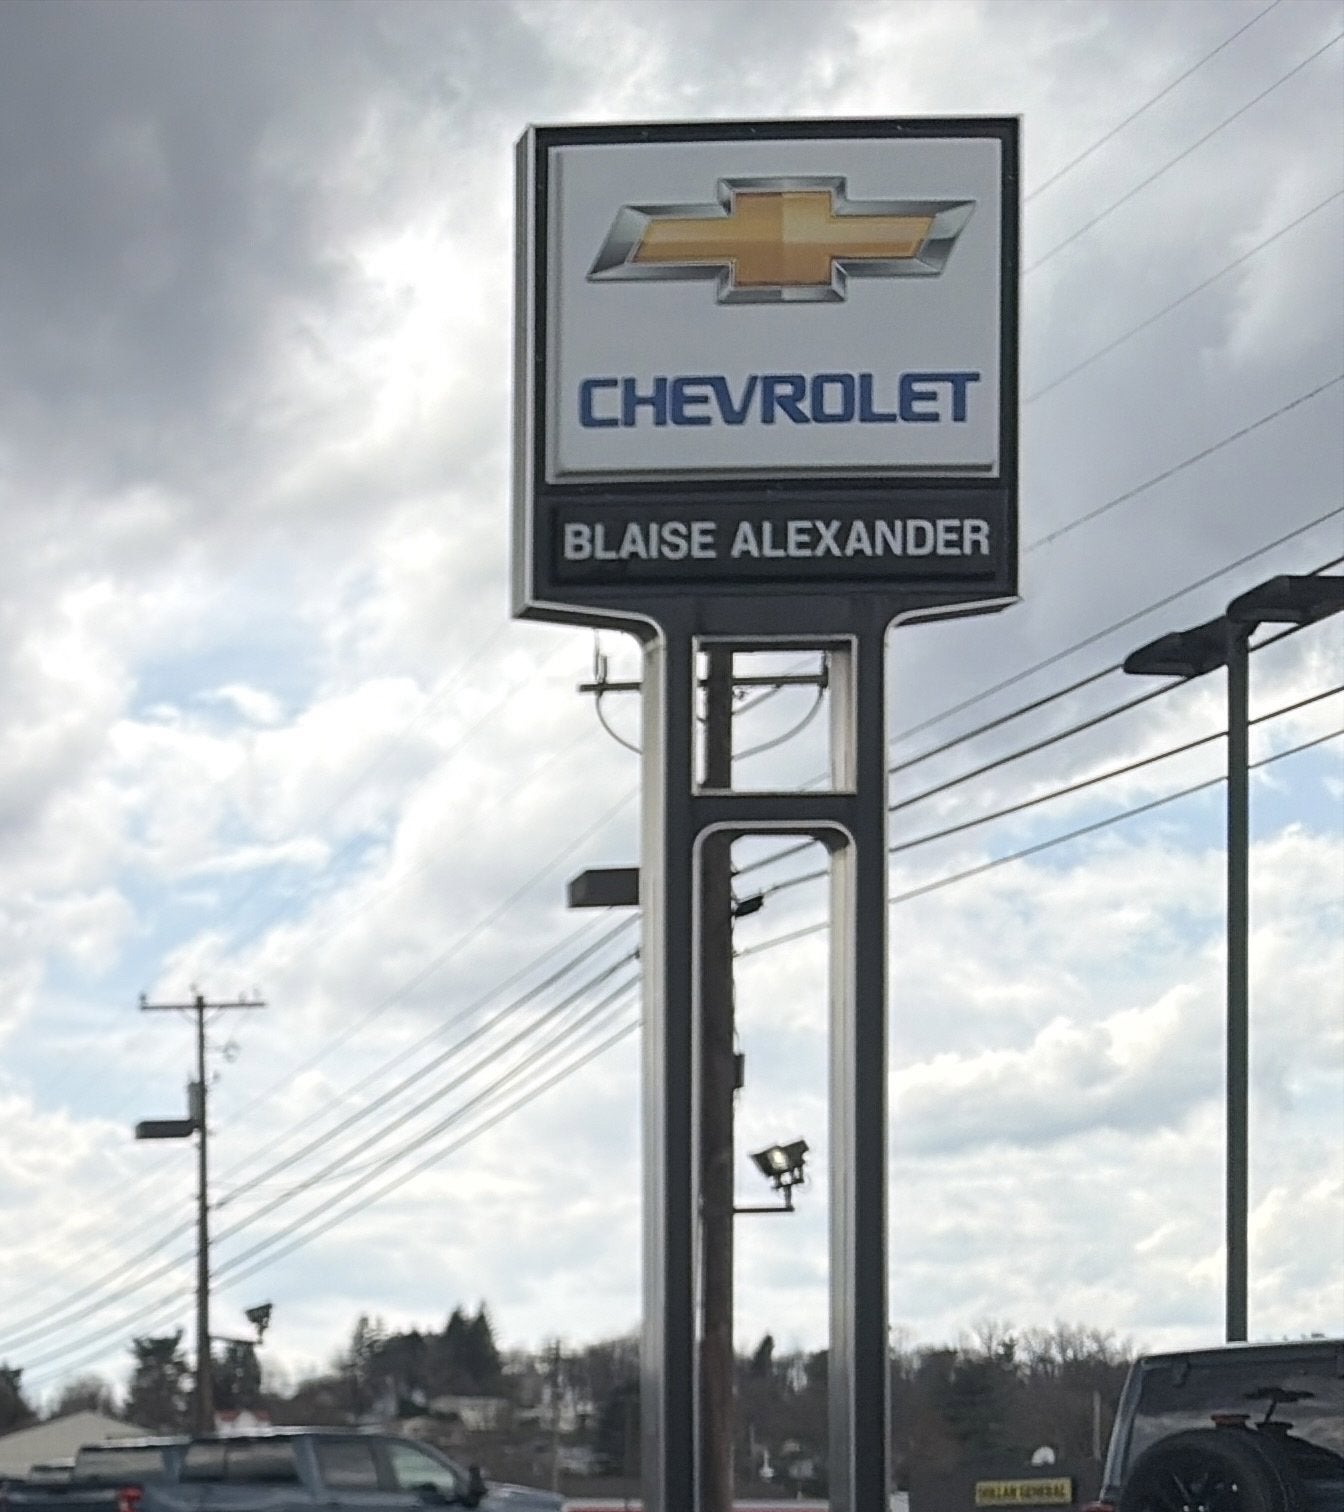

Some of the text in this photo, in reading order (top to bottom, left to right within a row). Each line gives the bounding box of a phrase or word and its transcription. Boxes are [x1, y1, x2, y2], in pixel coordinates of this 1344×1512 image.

[579, 372, 981, 427] CHEVROLET
[563, 518, 991, 561] BLAISE ALEXANDER
